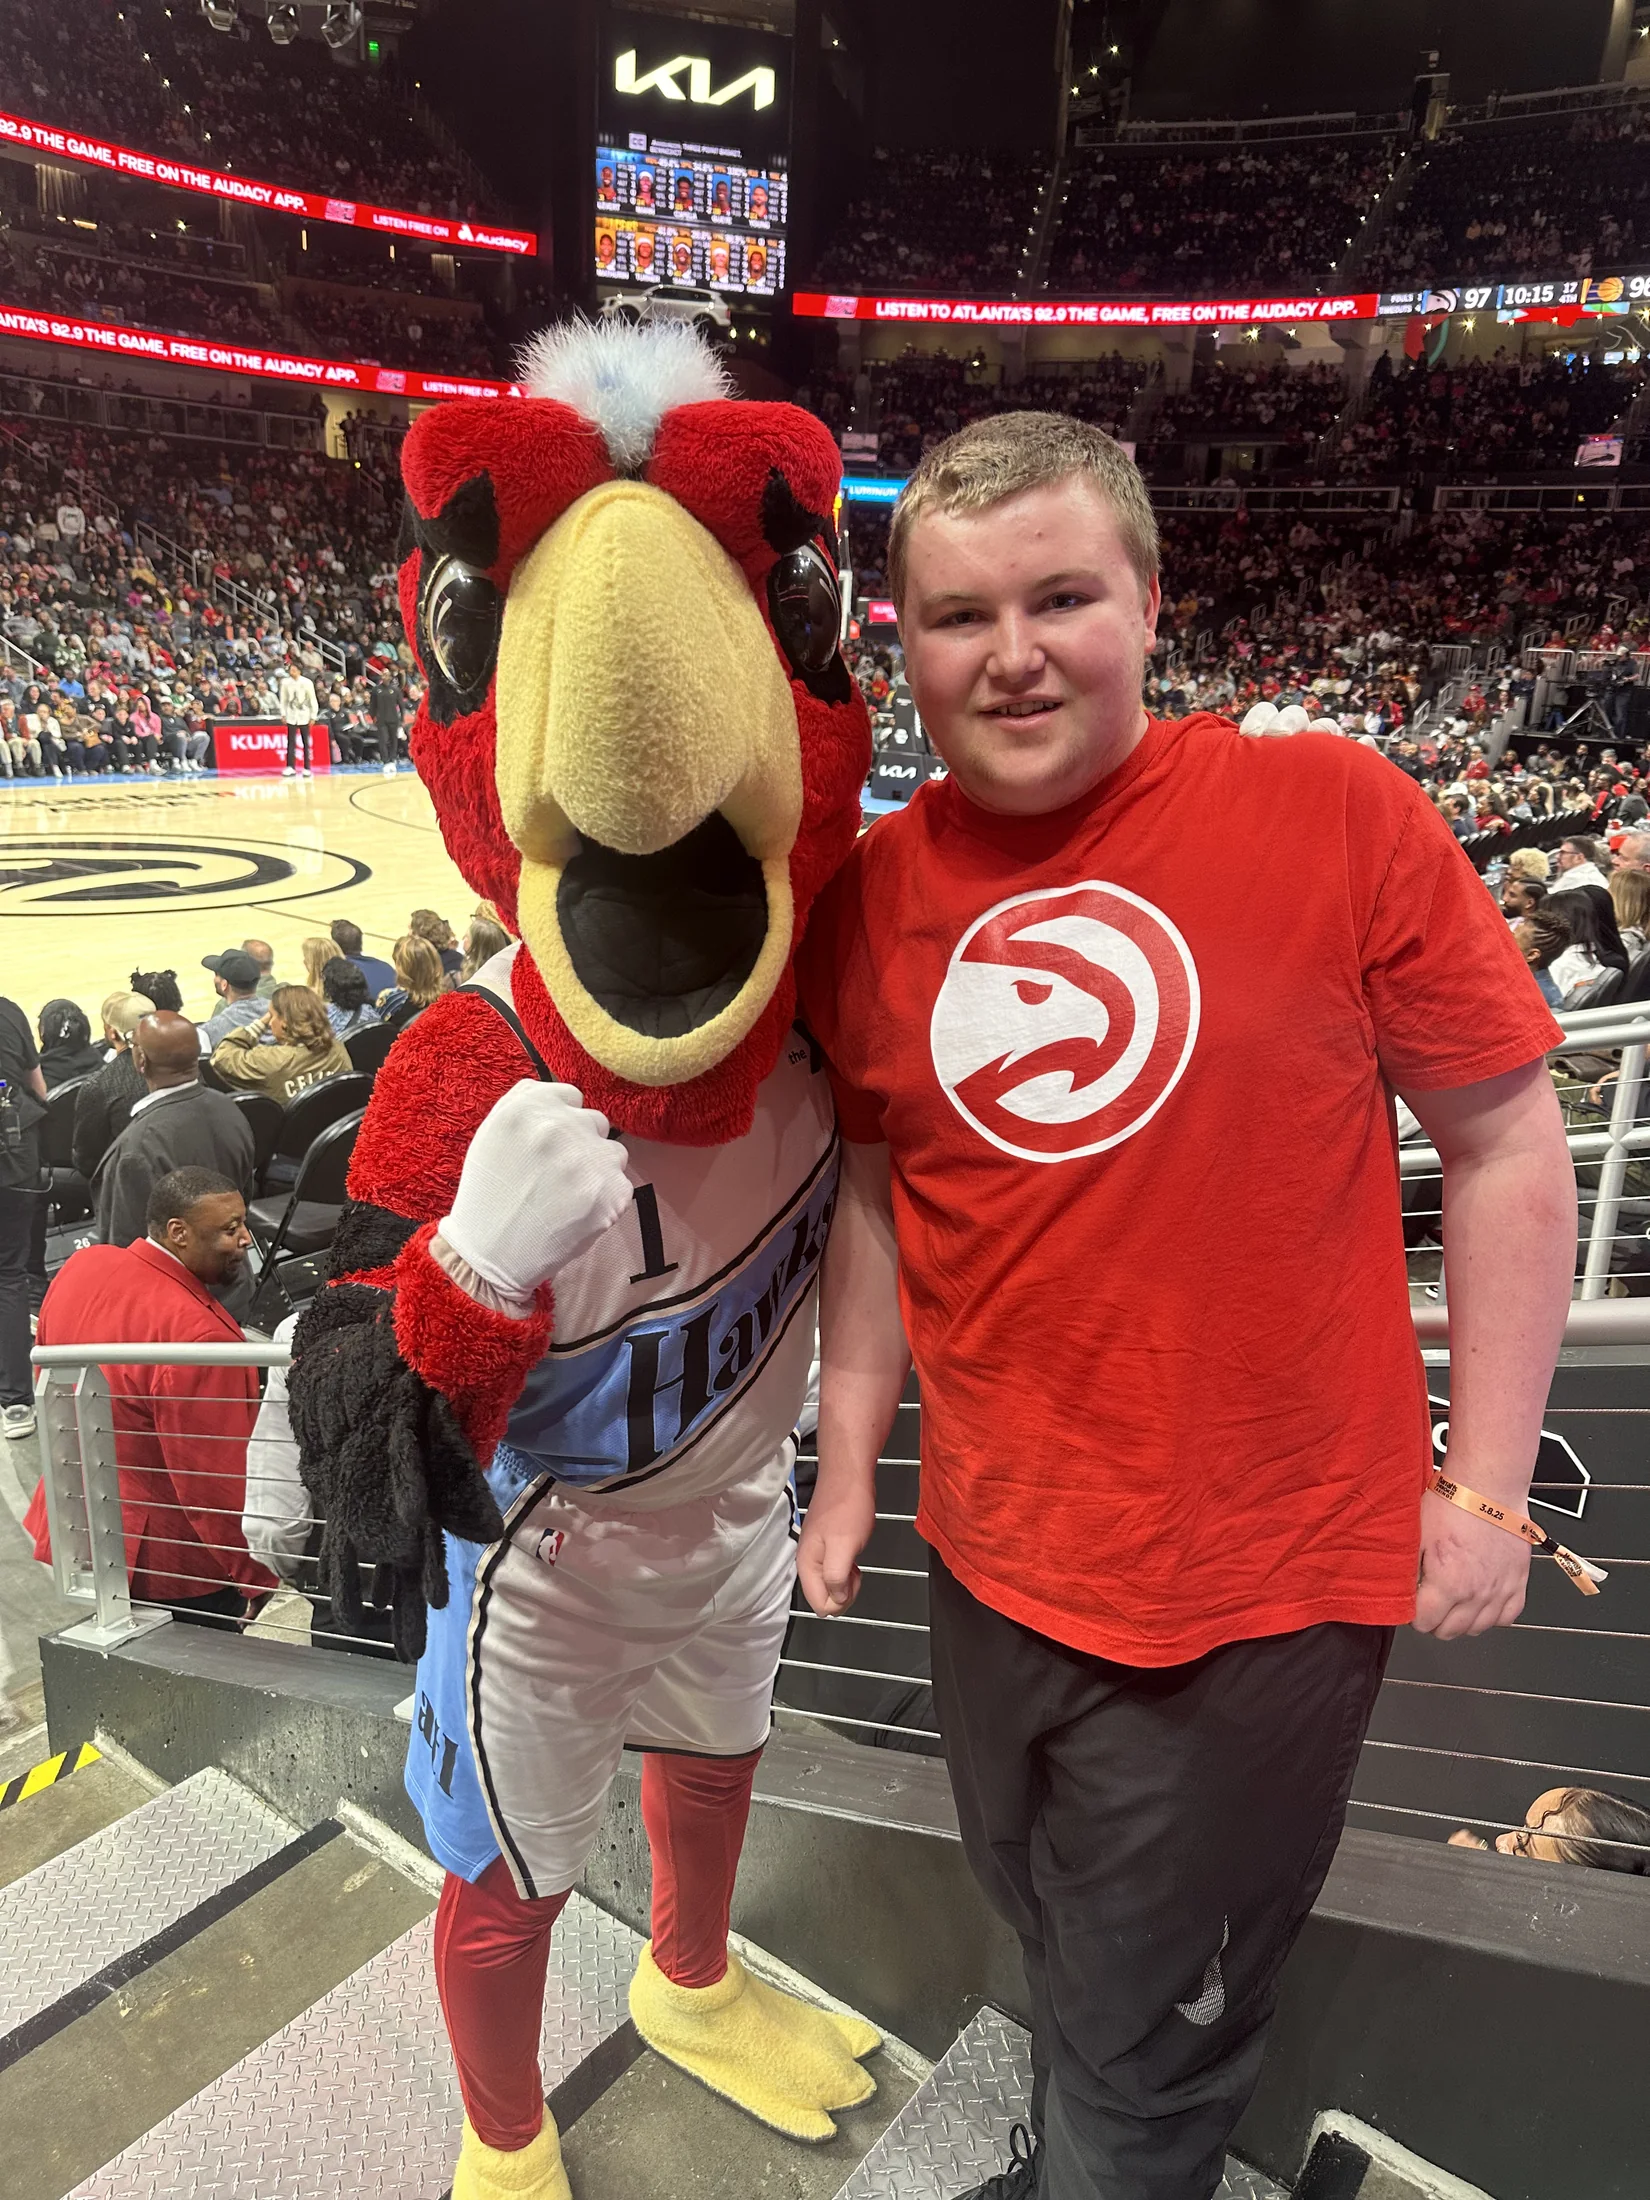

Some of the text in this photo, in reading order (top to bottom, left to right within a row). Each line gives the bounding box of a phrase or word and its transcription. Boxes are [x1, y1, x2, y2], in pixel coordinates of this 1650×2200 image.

[616, 49, 775, 111] KIA
[0, 118, 31, 140] 92.9
[32, 128, 65, 150] THE
[67, 138, 116, 166] GAME,
[118, 152, 155, 175] FREE
[156, 164, 179, 181] ON
[180, 169, 211, 188] THE
[213, 177, 272, 203] AUDACY
[274, 191, 307, 212] APP.
[373, 213, 407, 229] LISTEN
[408, 219, 432, 234] FREE
[433, 225, 449, 237] ON
[475, 233, 529, 252] Audacy
[1505, 284, 1554, 305] 10:15
[1563, 281, 1578, 294] 17
[1464, 288, 1493, 309] 97
[1559, 293, 1578, 304] 4TH
[876, 301, 928, 317] LISTEN
[929, 304, 950, 318] TO
[952, 304, 1033, 321] ATLANTA'S
[1034, 306, 1067, 322] 92.9
[1068, 306, 1098, 322] THE
[1099, 306, 1149, 324] GAME,
[1152, 305, 1191, 322] FREE
[1193, 305, 1217, 321] ON
[1218, 303, 1250, 320] THE
[1251, 301, 1317, 319] AUDACY
[1319, 299, 1358, 317] APP.
[50, 322, 84, 340] 92.9
[84, 328, 117, 346] THE
[118, 334, 169, 356] GAME,
[170, 342, 208, 361] FREE
[209, 349, 231, 365] ON
[232, 353, 262, 370] THE
[263, 358, 324, 379] AUDACY
[325, 366, 360, 384] APP.
[422, 380, 457, 394] LISTEN
[457, 384, 482, 397] FREE
[483, 386, 499, 397] ON
[879, 764, 917, 779] KIA
[788, 1049, 808, 1065] the
[73, 1237, 91, 1250] 26
[1479, 1503, 1505, 1521] 3.8.25
